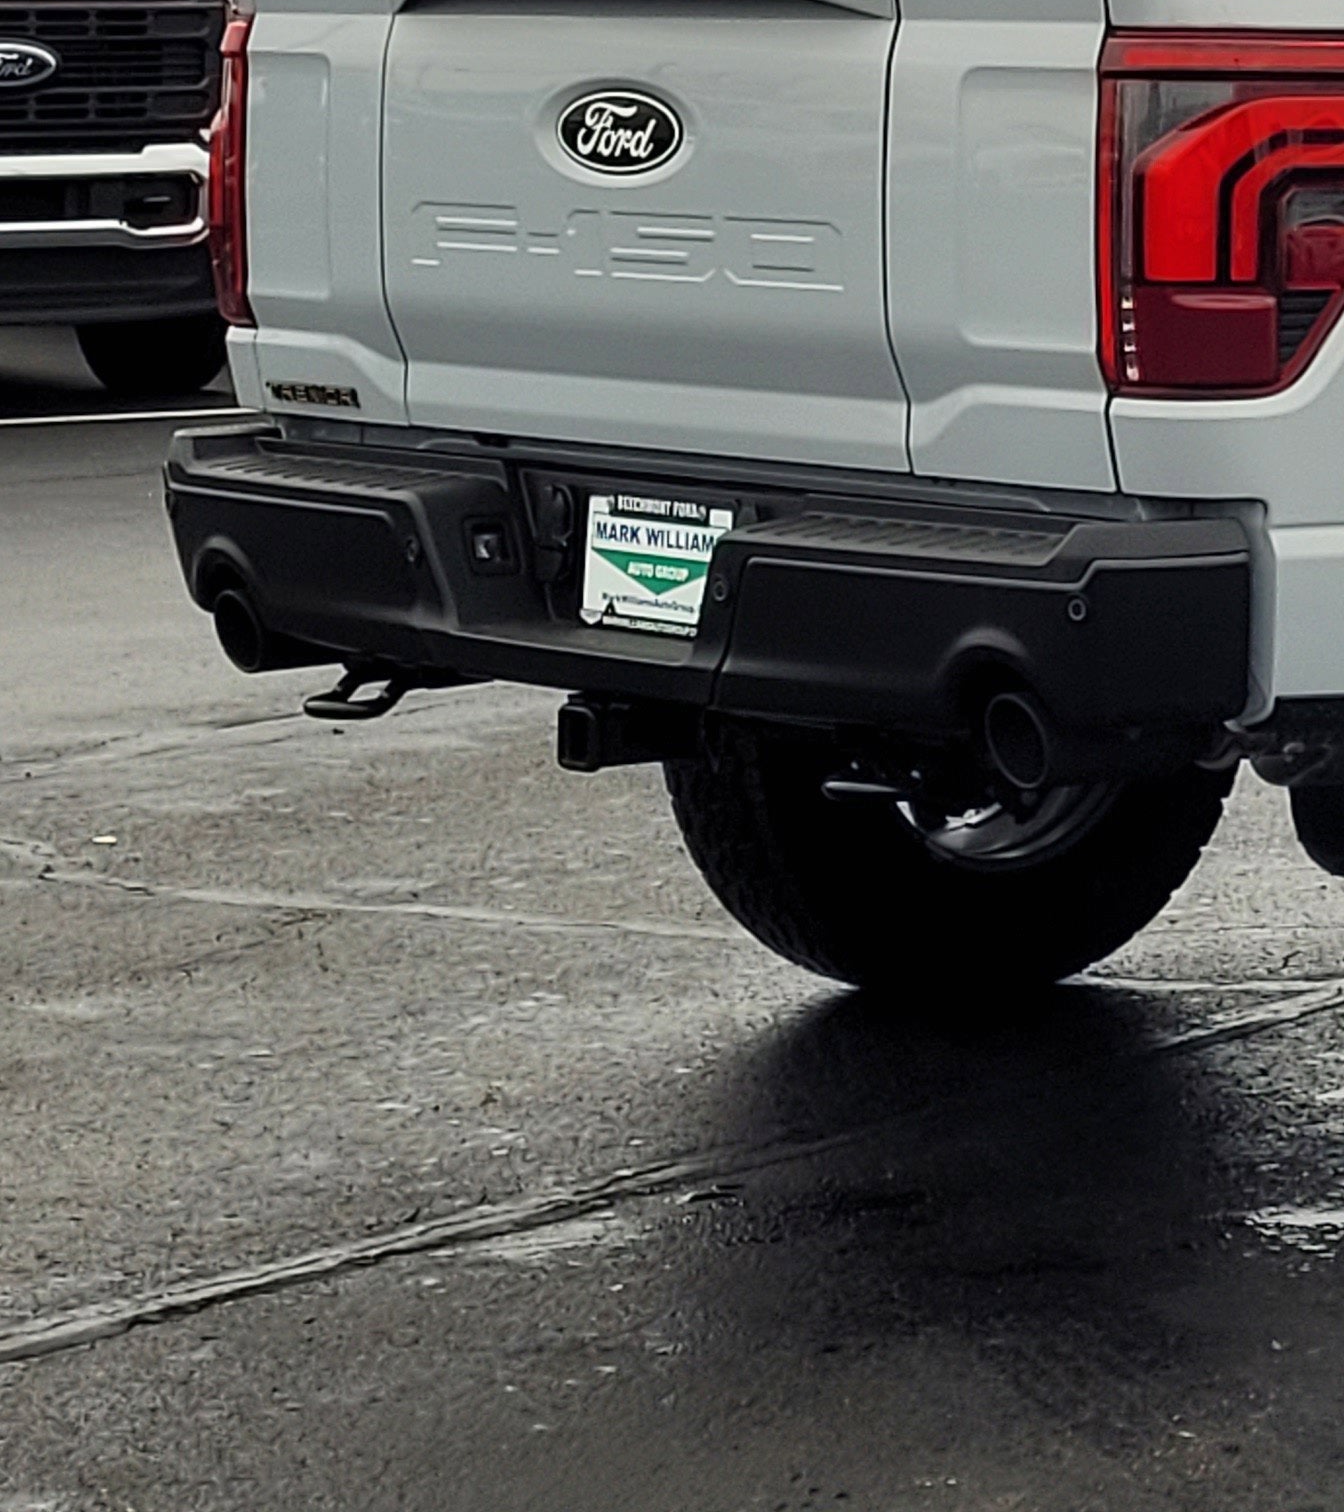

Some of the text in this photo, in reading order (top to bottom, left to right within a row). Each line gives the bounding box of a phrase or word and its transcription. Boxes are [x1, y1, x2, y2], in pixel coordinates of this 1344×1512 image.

[577, 101, 657, 160] Ford
[411, 201, 844, 291] F-150
[596, 521, 641, 544] MARK
